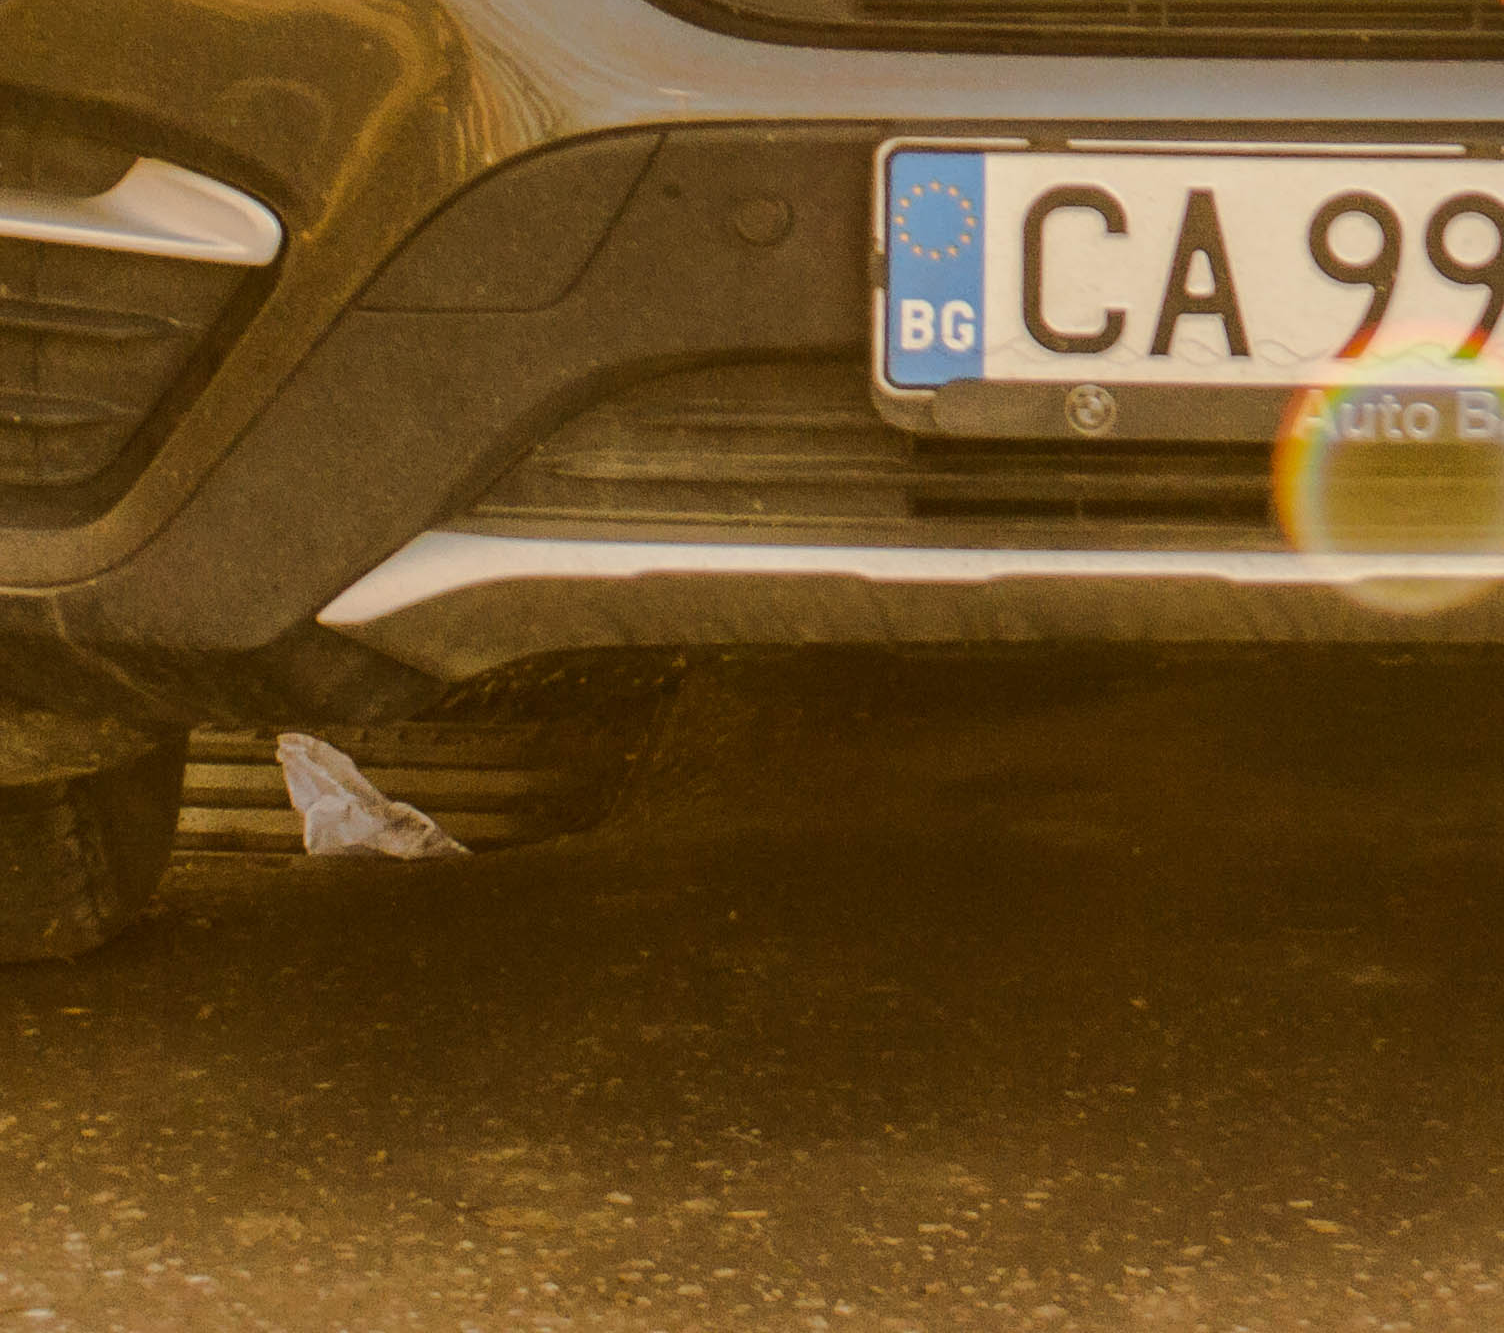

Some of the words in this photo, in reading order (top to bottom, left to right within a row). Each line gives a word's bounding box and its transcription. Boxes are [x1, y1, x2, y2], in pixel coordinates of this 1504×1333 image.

[1022, 183, 1251, 358] CA
[900, 298, 976, 352] BG
[1298, 388, 1440, 444] Auto
